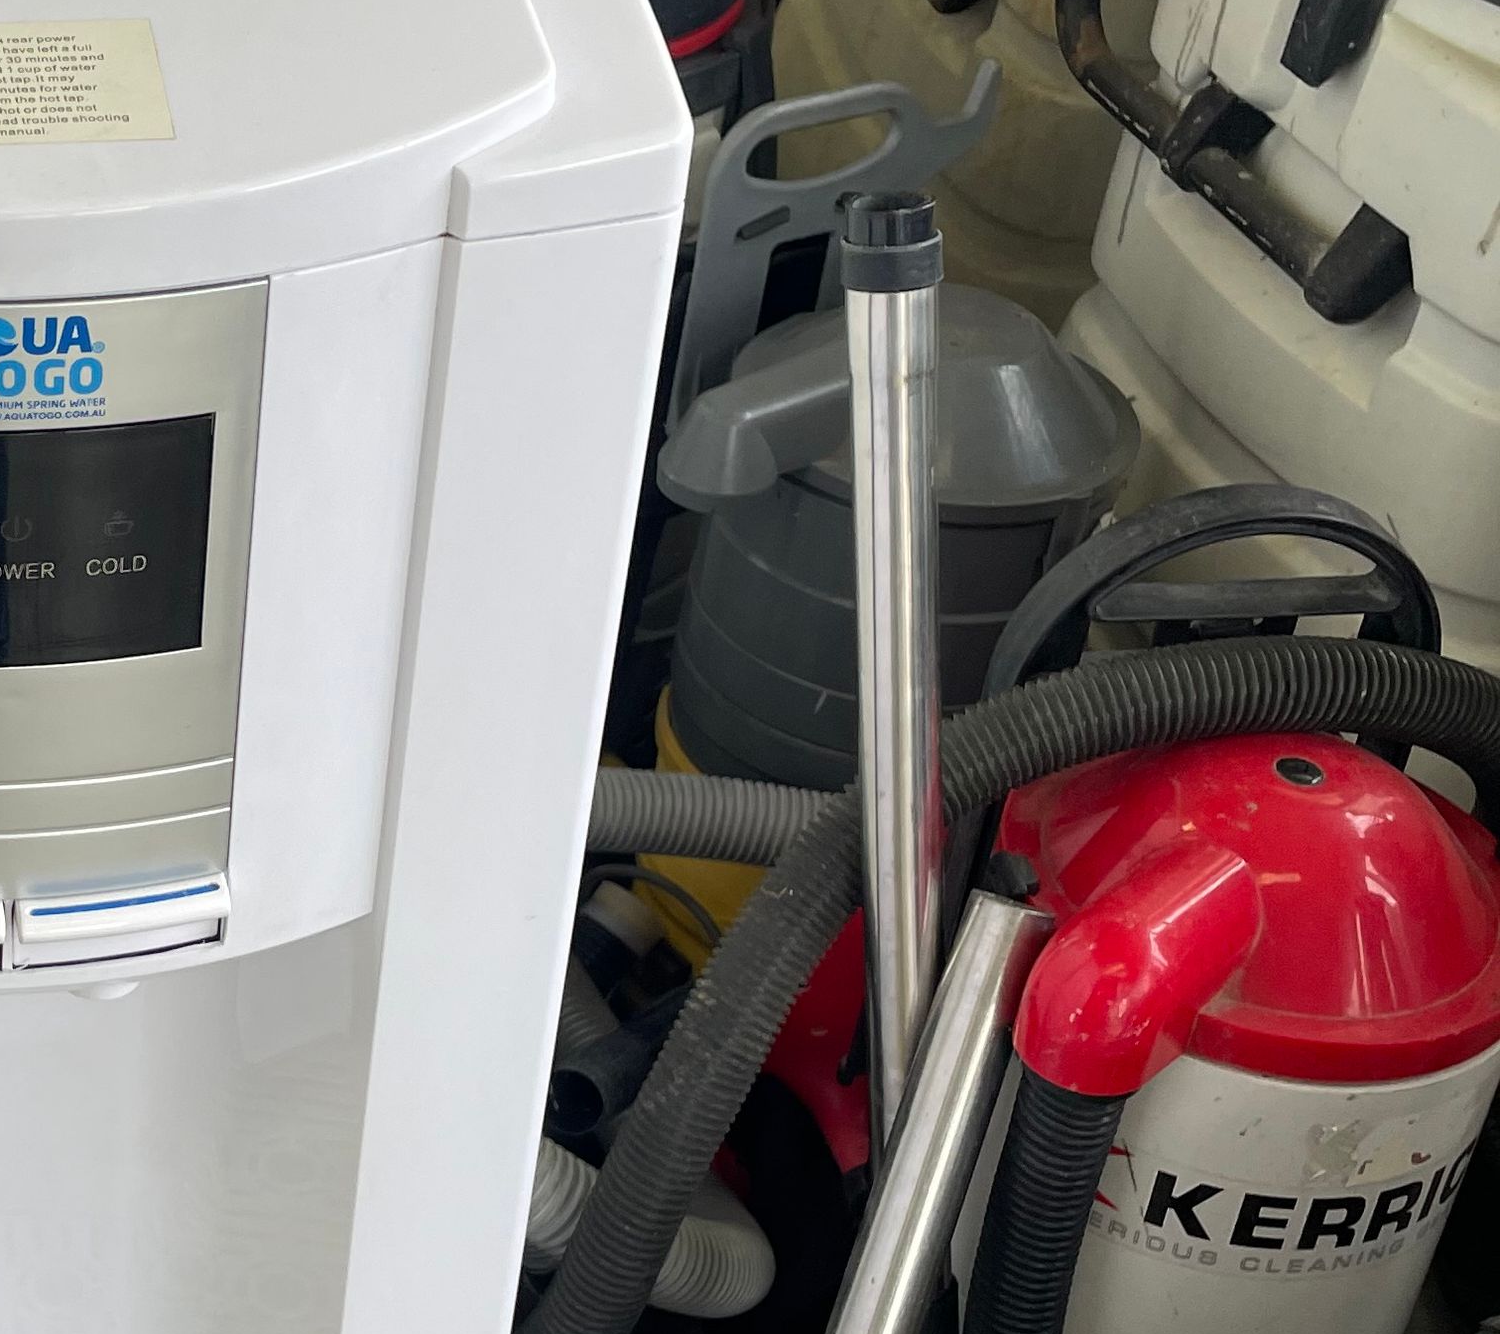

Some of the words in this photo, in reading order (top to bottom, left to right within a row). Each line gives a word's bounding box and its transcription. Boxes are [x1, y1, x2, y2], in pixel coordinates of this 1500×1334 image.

[37, 36, 76, 44] power
[48, 75, 74, 83] may
[40, 105, 72, 113] does
[22, 115, 68, 124] trouble
[72, 114, 129, 123] shooting
[27, 399, 66, 409] SPRING
[70, 398, 106, 407] WATER
[86, 555, 148, 577] COLD
[1143, 1138, 1477, 1251] KERRIC
[1088, 1210, 1217, 1266] ERIOUS
[1240, 1239, 1405, 1273] CLEANING
